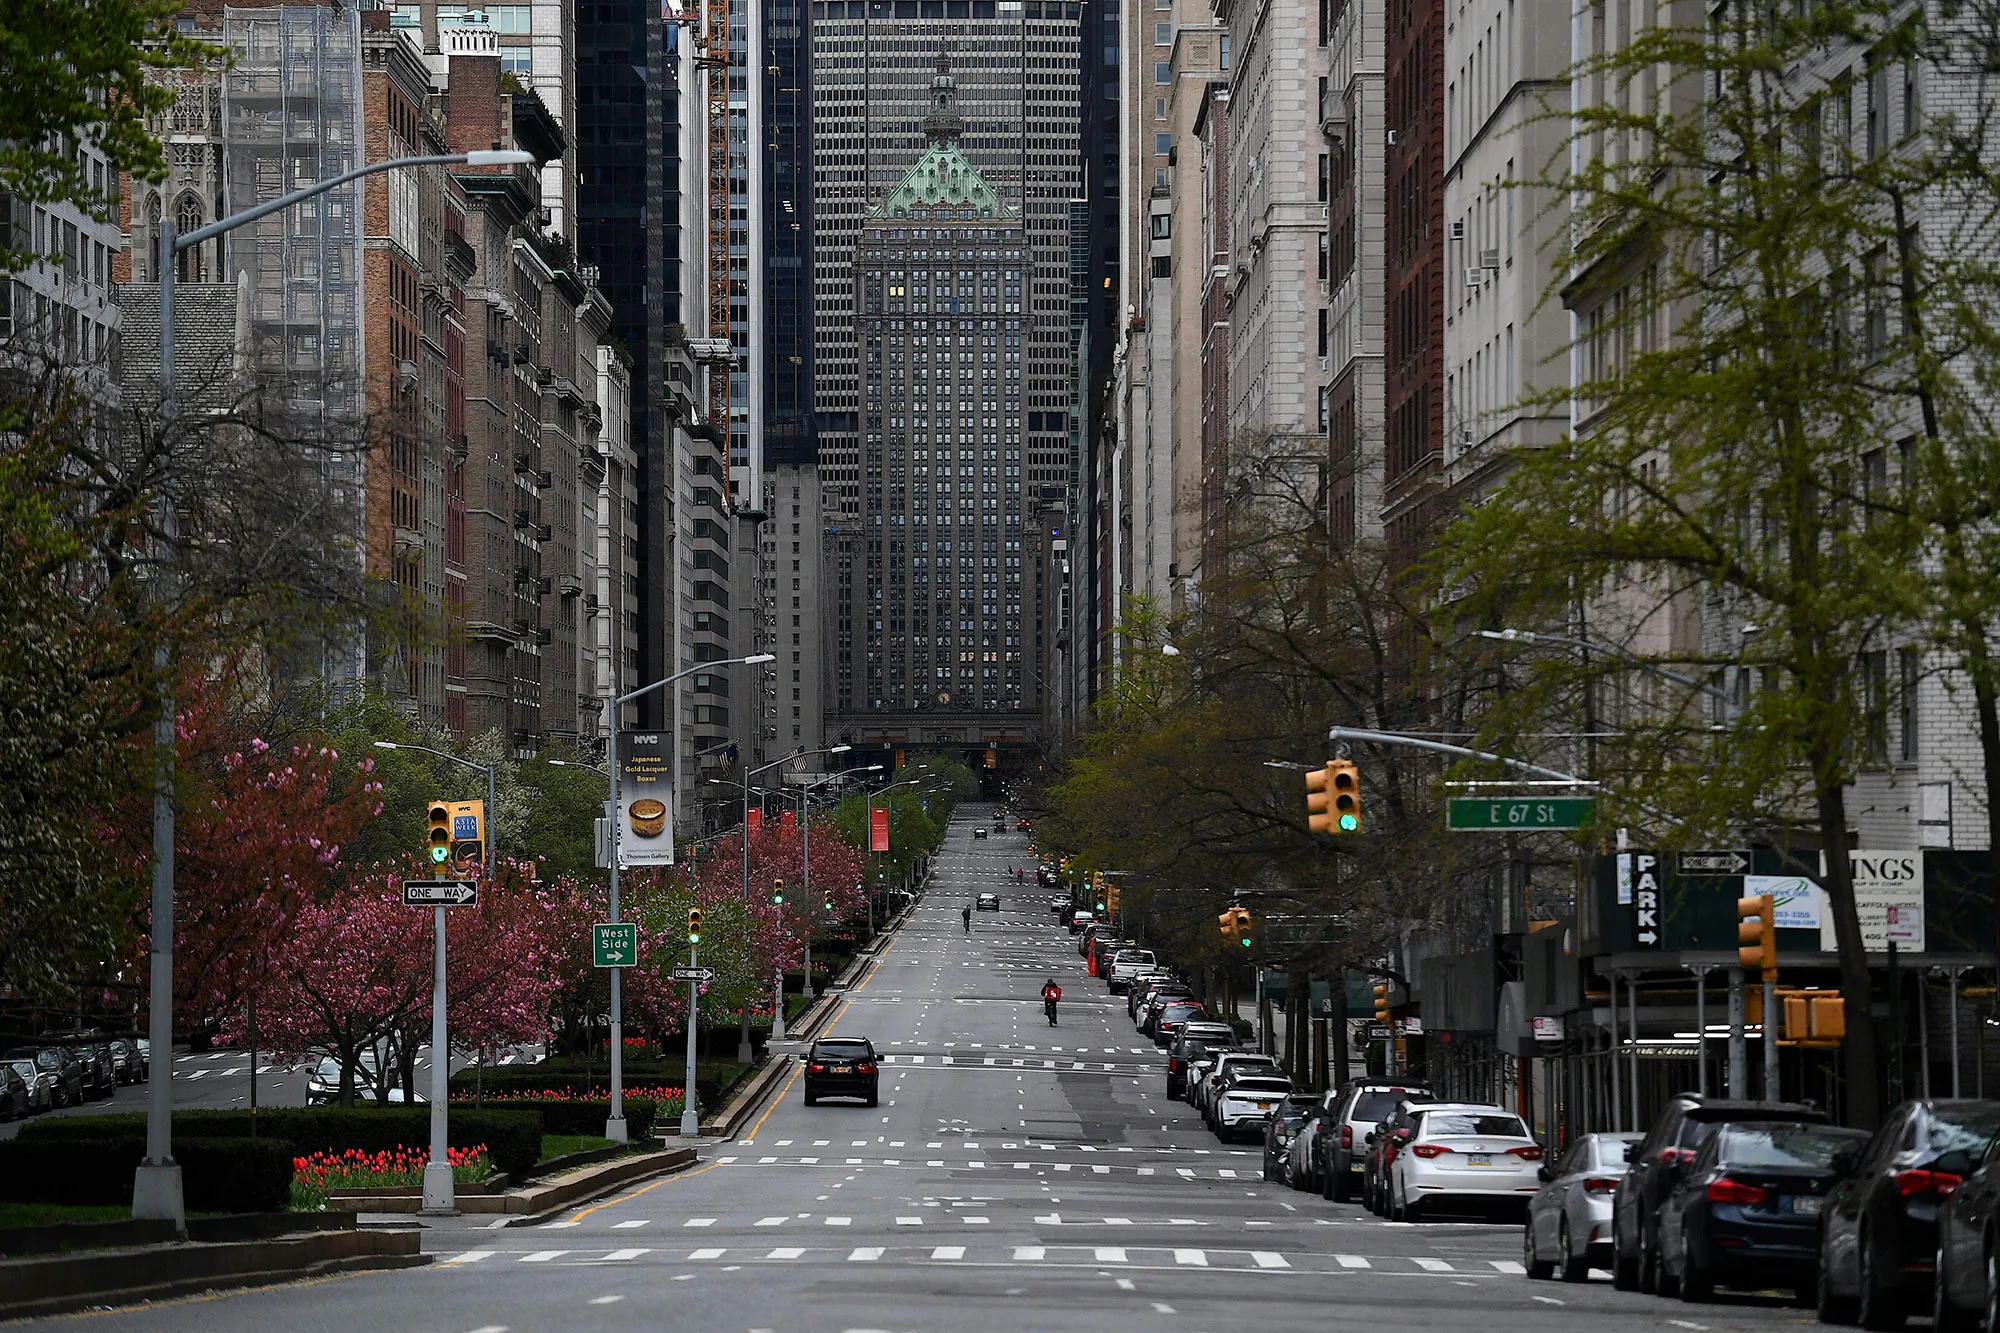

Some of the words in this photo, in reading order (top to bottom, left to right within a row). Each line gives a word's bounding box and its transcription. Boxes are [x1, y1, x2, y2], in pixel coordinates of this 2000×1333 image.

[634, 735, 658, 744] NYC
[631, 755, 661, 764] Japanese
[625, 765, 641, 773] Gold
[642, 765, 668, 775] Lacquer
[1490, 804, 1501, 823] E
[1508, 804, 1529, 823] 67
[1537, 804, 1555, 823] St
[1850, 858, 1915, 881] INGS
[410, 888, 431, 898] ONE
[443, 888, 467, 898] WAY
[1637, 855, 1658, 927] PARK
[600, 928, 629, 938] West
[602, 939, 628, 949] Side
